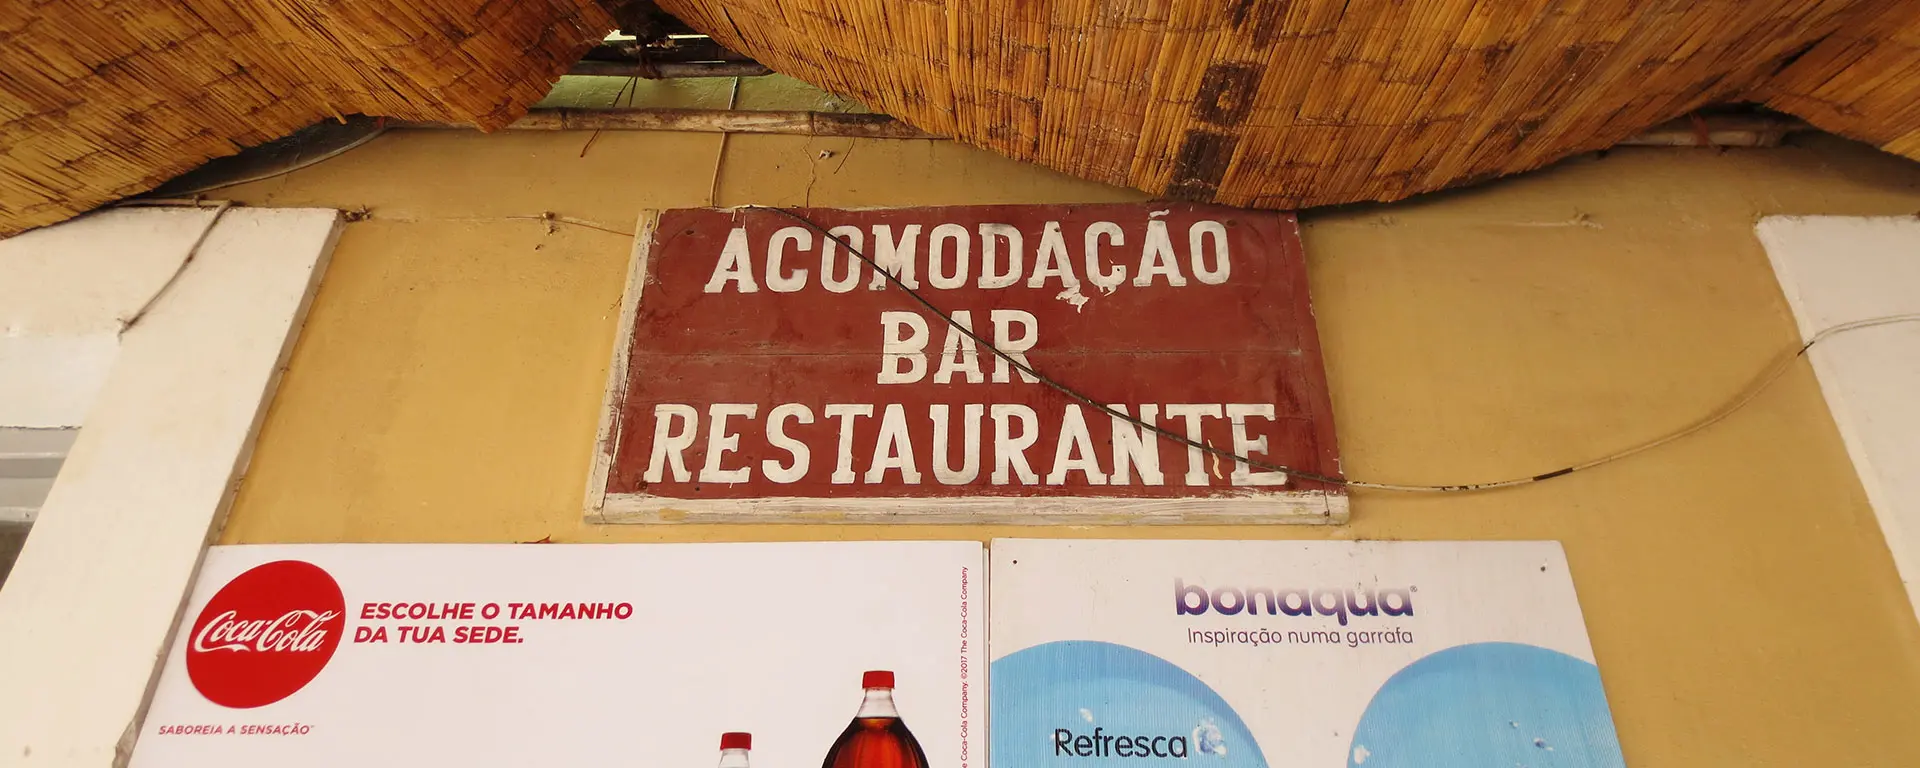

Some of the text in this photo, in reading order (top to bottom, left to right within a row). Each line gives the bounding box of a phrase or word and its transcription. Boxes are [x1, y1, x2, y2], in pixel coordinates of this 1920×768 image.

[703, 209, 1232, 294] ACOMODAÇÃO
[877, 309, 1041, 385] BAR
[643, 402, 1289, 487] RESTAURANTE
[960, 566, 969, 600] Company
[360, 602, 634, 620] ESCOLHE O TAMANHO
[960, 601, 968, 638] Coca-Cola
[194, 609, 342, 653] Coca-Cola
[353, 625, 524, 644] DA TUA SEDE.
[960, 640, 968, 654] The
[1187, 627, 1414, 648] Inspiração numa garrafa
[158, 724, 223, 735] SABOREIA
[226, 724, 236, 735] A
[960, 720, 968, 762] Coca-Cola
[1054, 726, 1188, 758] Refresca
